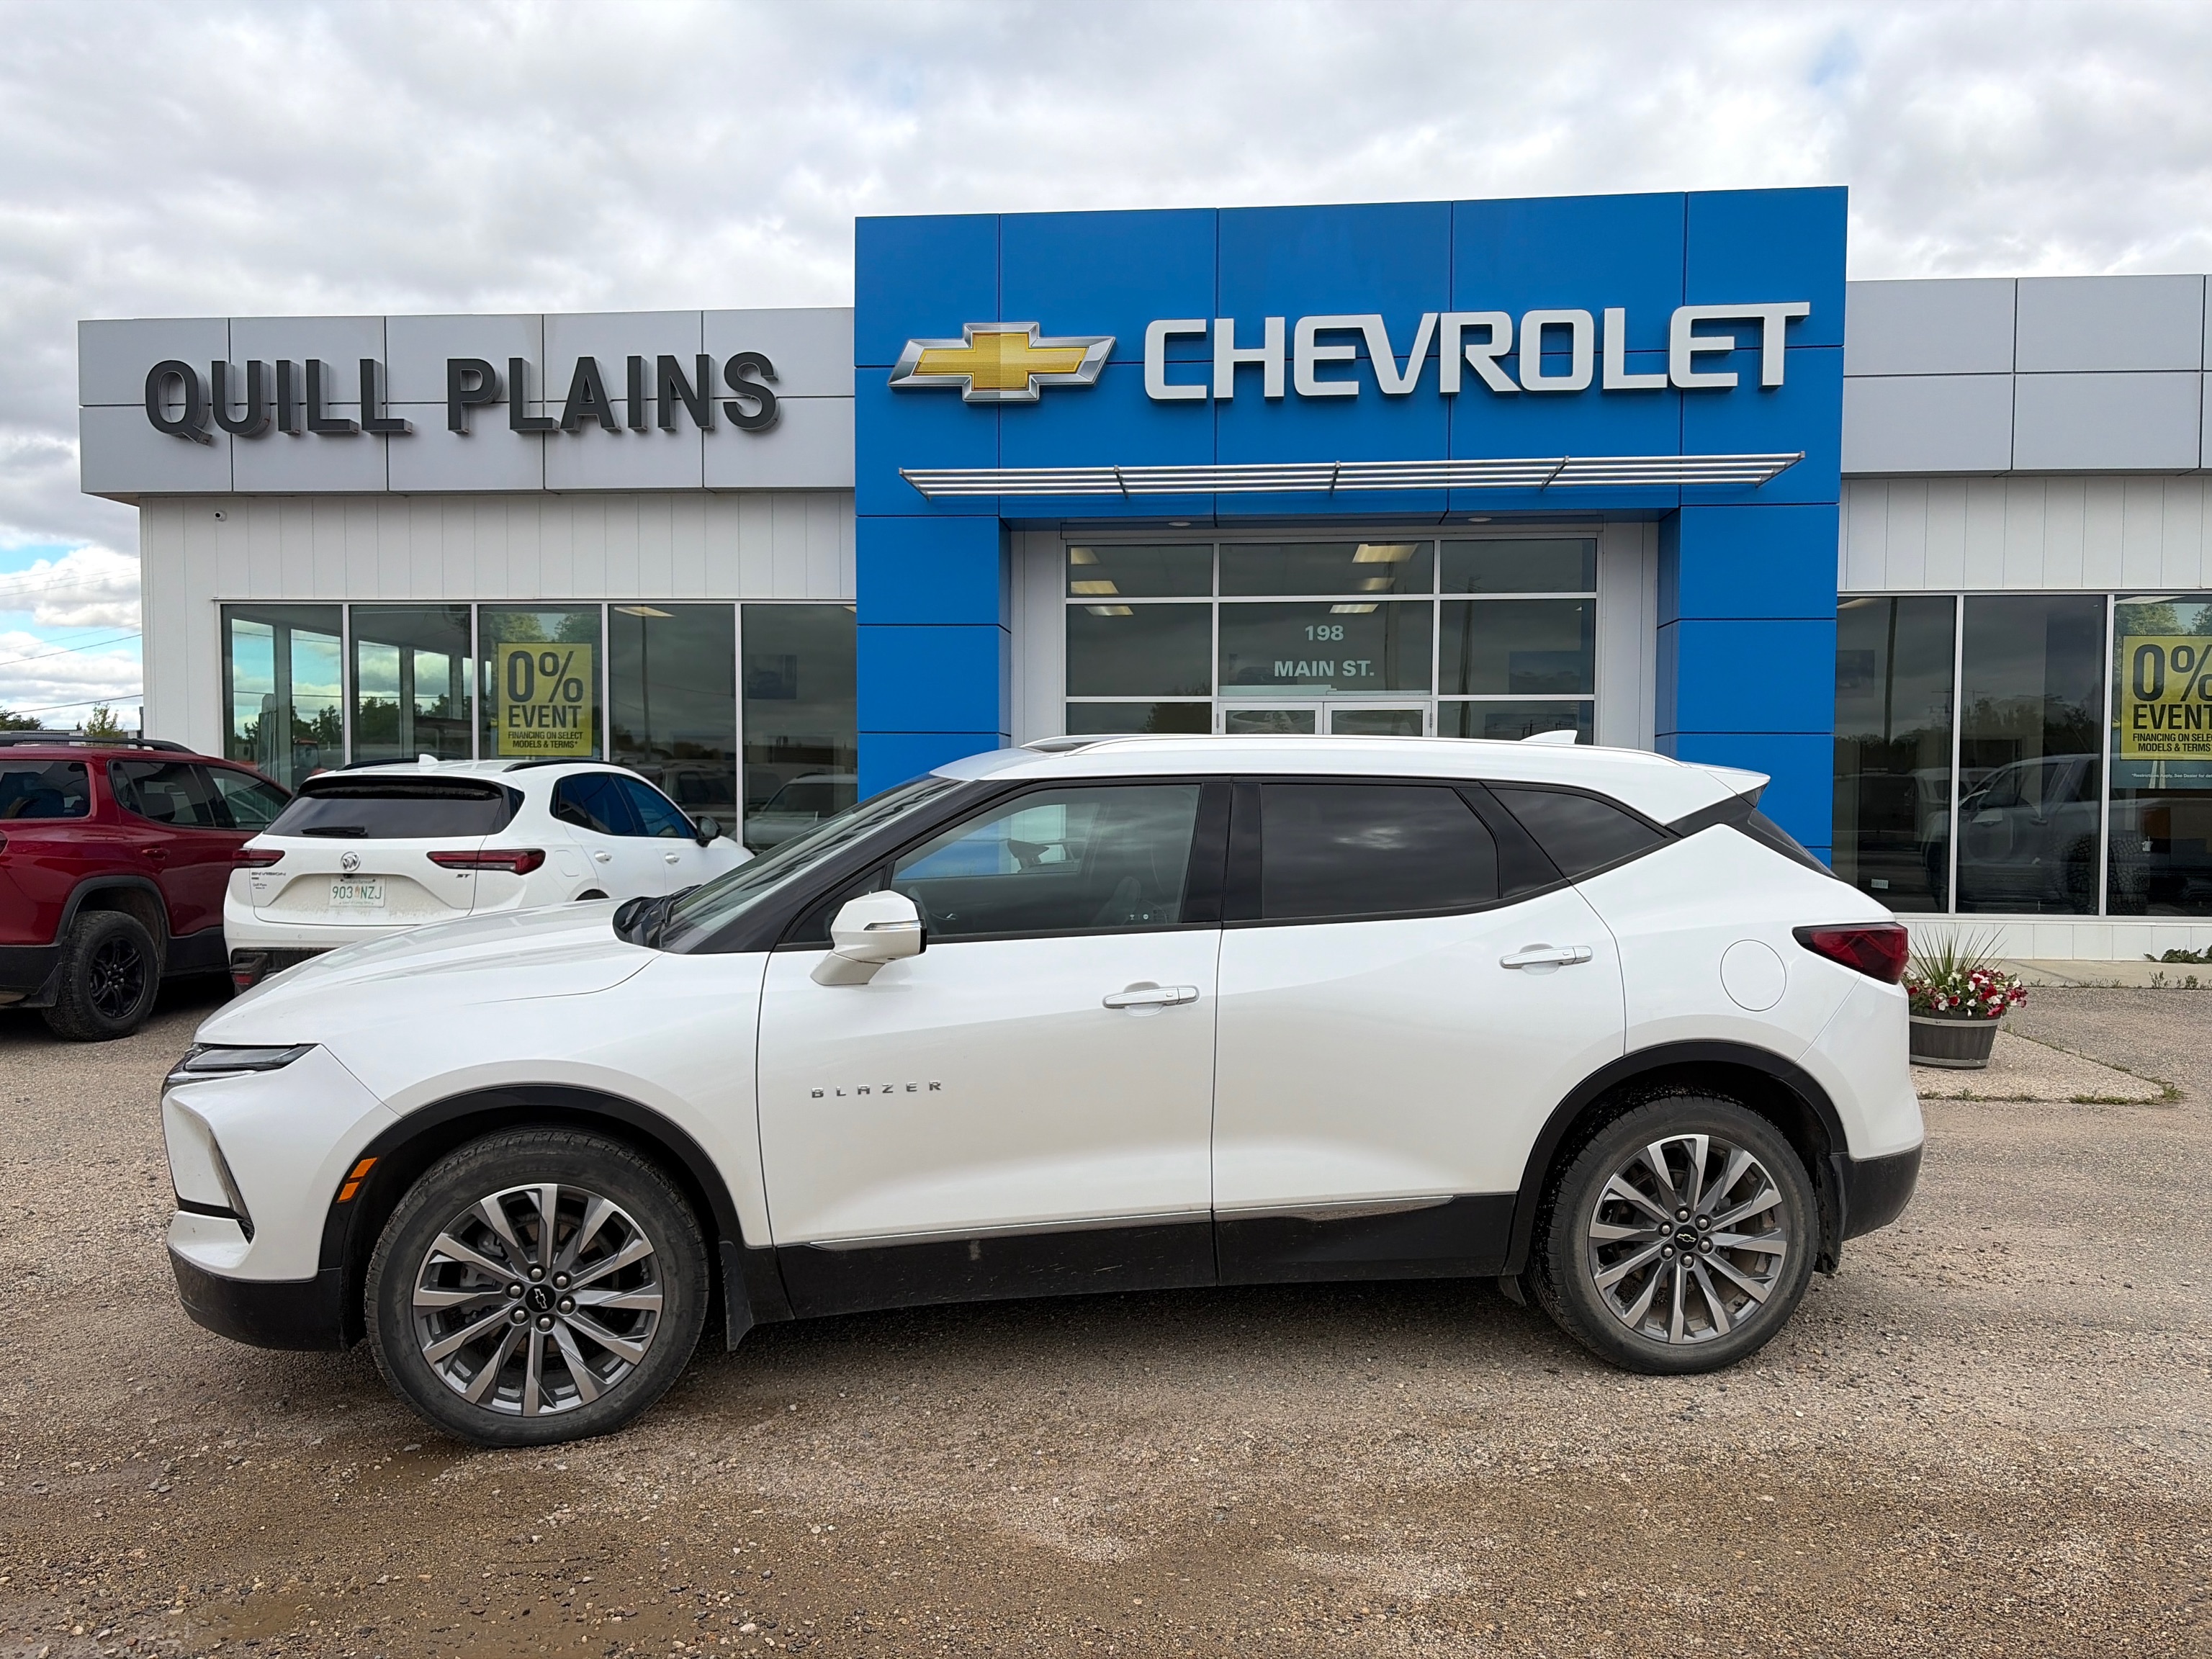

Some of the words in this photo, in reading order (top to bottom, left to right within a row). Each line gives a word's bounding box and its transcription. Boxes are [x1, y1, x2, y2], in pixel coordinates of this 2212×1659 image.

[1144, 301, 1810, 400] CHEVROLET
[144, 359, 413, 444] QUILL
[446, 351, 781, 434] PLAINS
[1305, 625, 1344, 641] 198
[507, 650, 584, 703] 0%
[1274, 660, 1334, 677] MAIN
[1342, 660, 1375, 677] ST.
[2133, 644, 2212, 702] 0%
[508, 704, 583, 729] EVENT
[2133, 703, 2212, 730] EVENT
[508, 731, 545, 739] FINANCING
[547, 731, 557, 739] ON
[558, 732, 583, 740] SELECT
[2132, 733, 2176, 742] FINANCING
[2178, 733, 2190, 742] ON
[2191, 733, 2212, 742] SELE
[2138, 743, 2172, 752] MODELS
[2174, 742, 2181, 752] &
[332, 886, 353, 899] 903
[361, 886, 382, 899] NZJ
[811, 1080, 941, 1098] BLAZER
